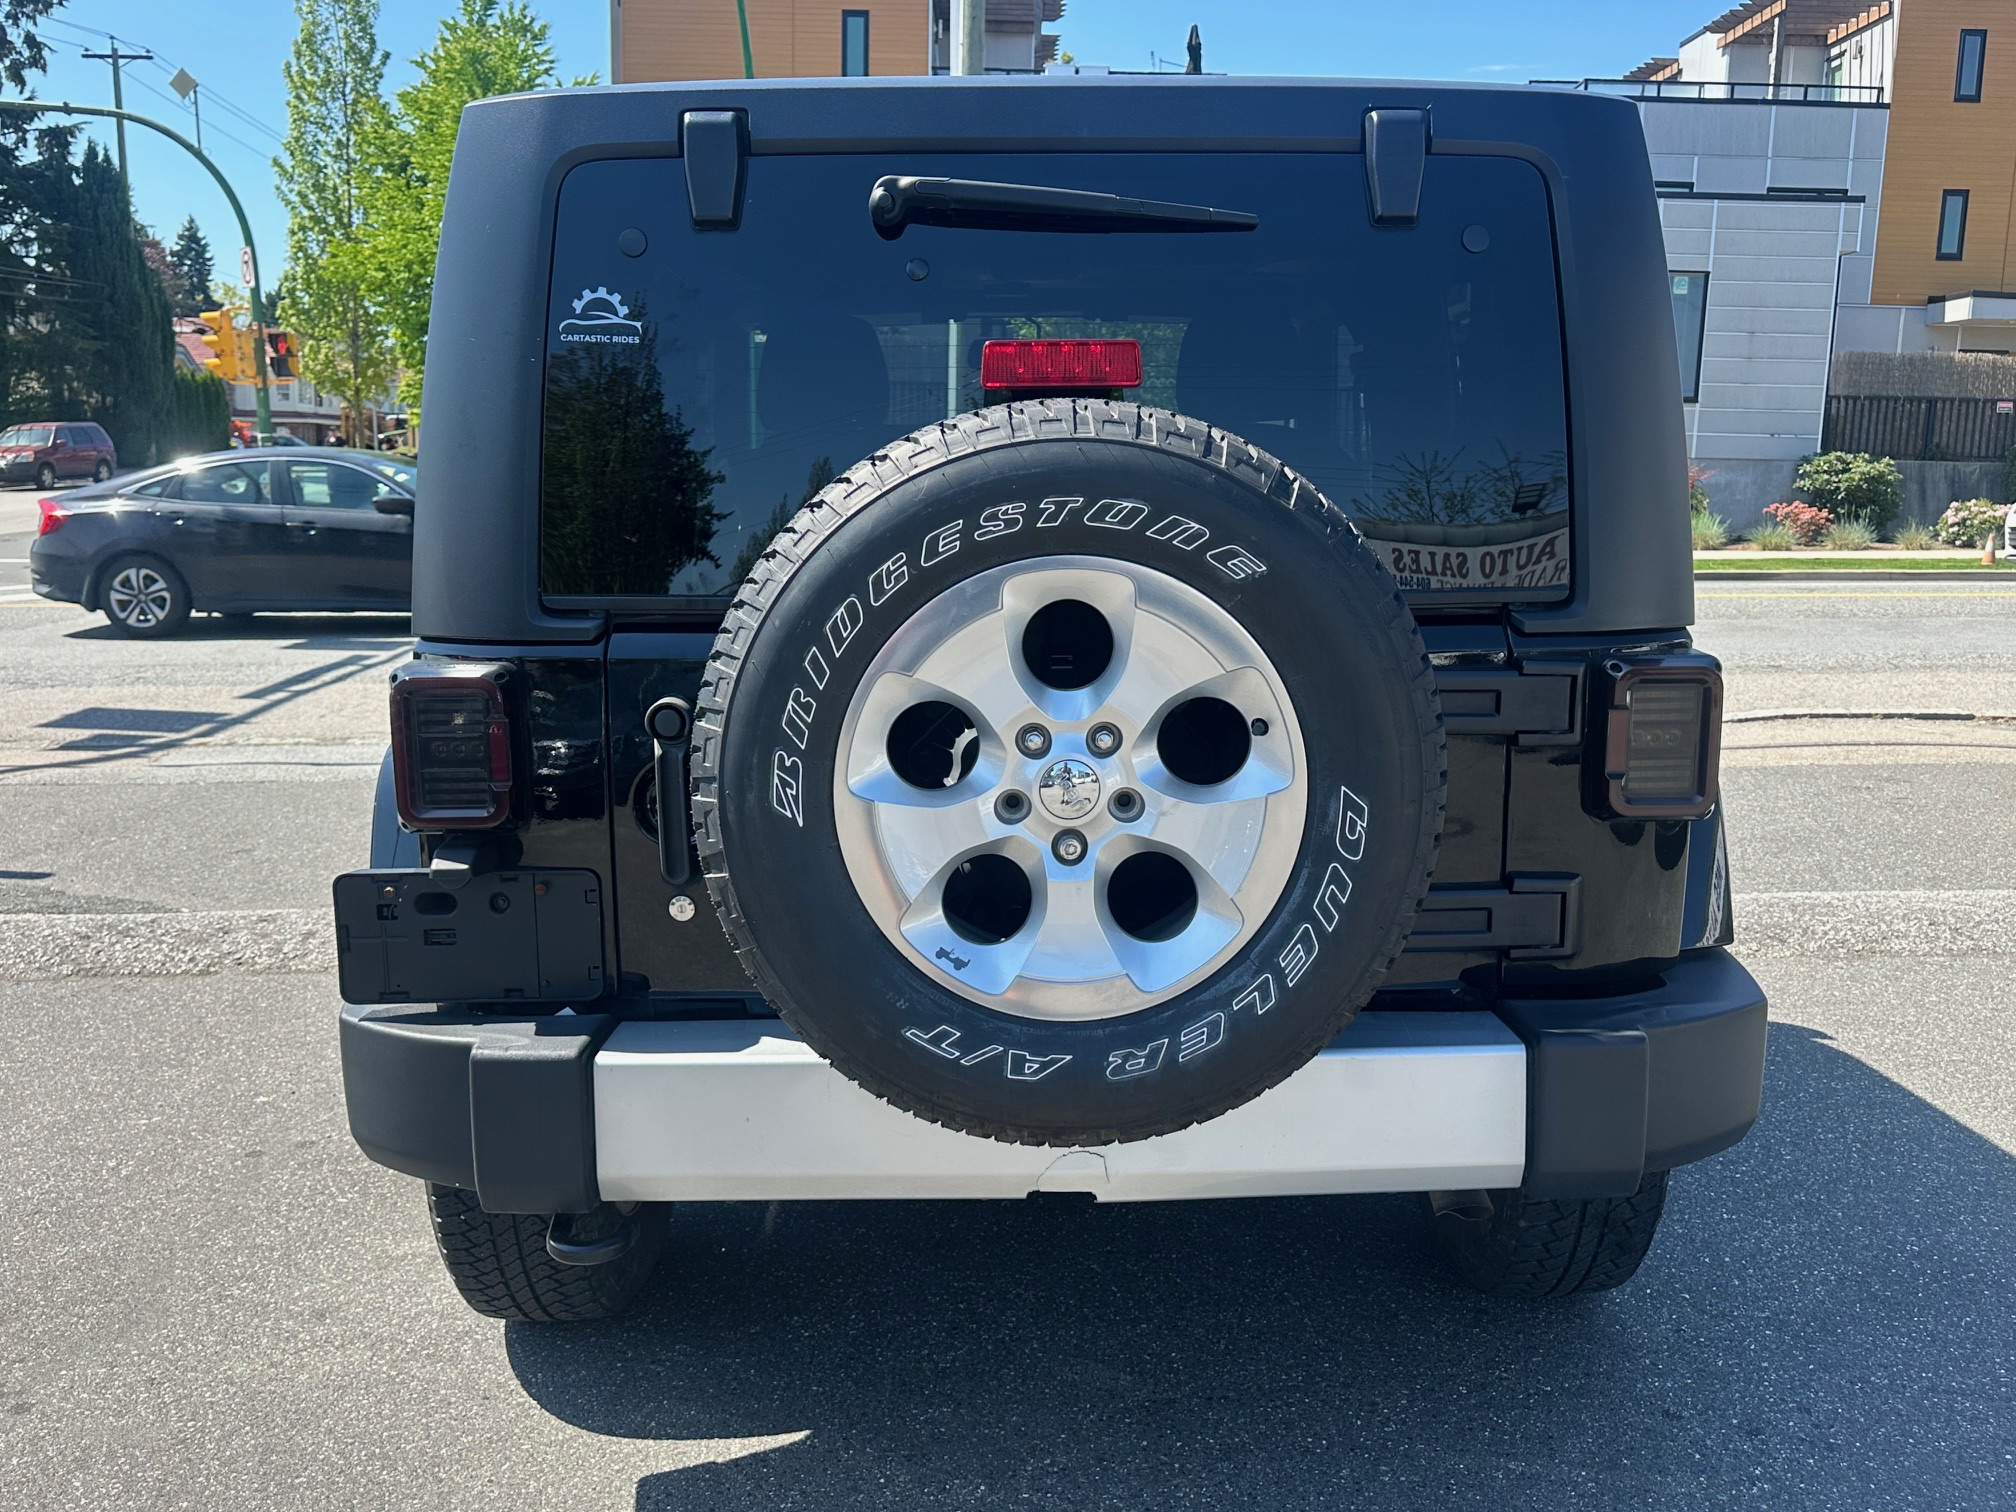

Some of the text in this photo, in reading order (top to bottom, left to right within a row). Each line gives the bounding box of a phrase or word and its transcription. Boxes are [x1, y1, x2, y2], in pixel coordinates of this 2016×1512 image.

[560, 334, 640, 344] CARTASTIC RIDES
[773, 497, 1267, 828] BRIDGESTONE
[1106, 785, 1368, 1080] DUELER
[905, 1025, 1074, 1081] A/T
